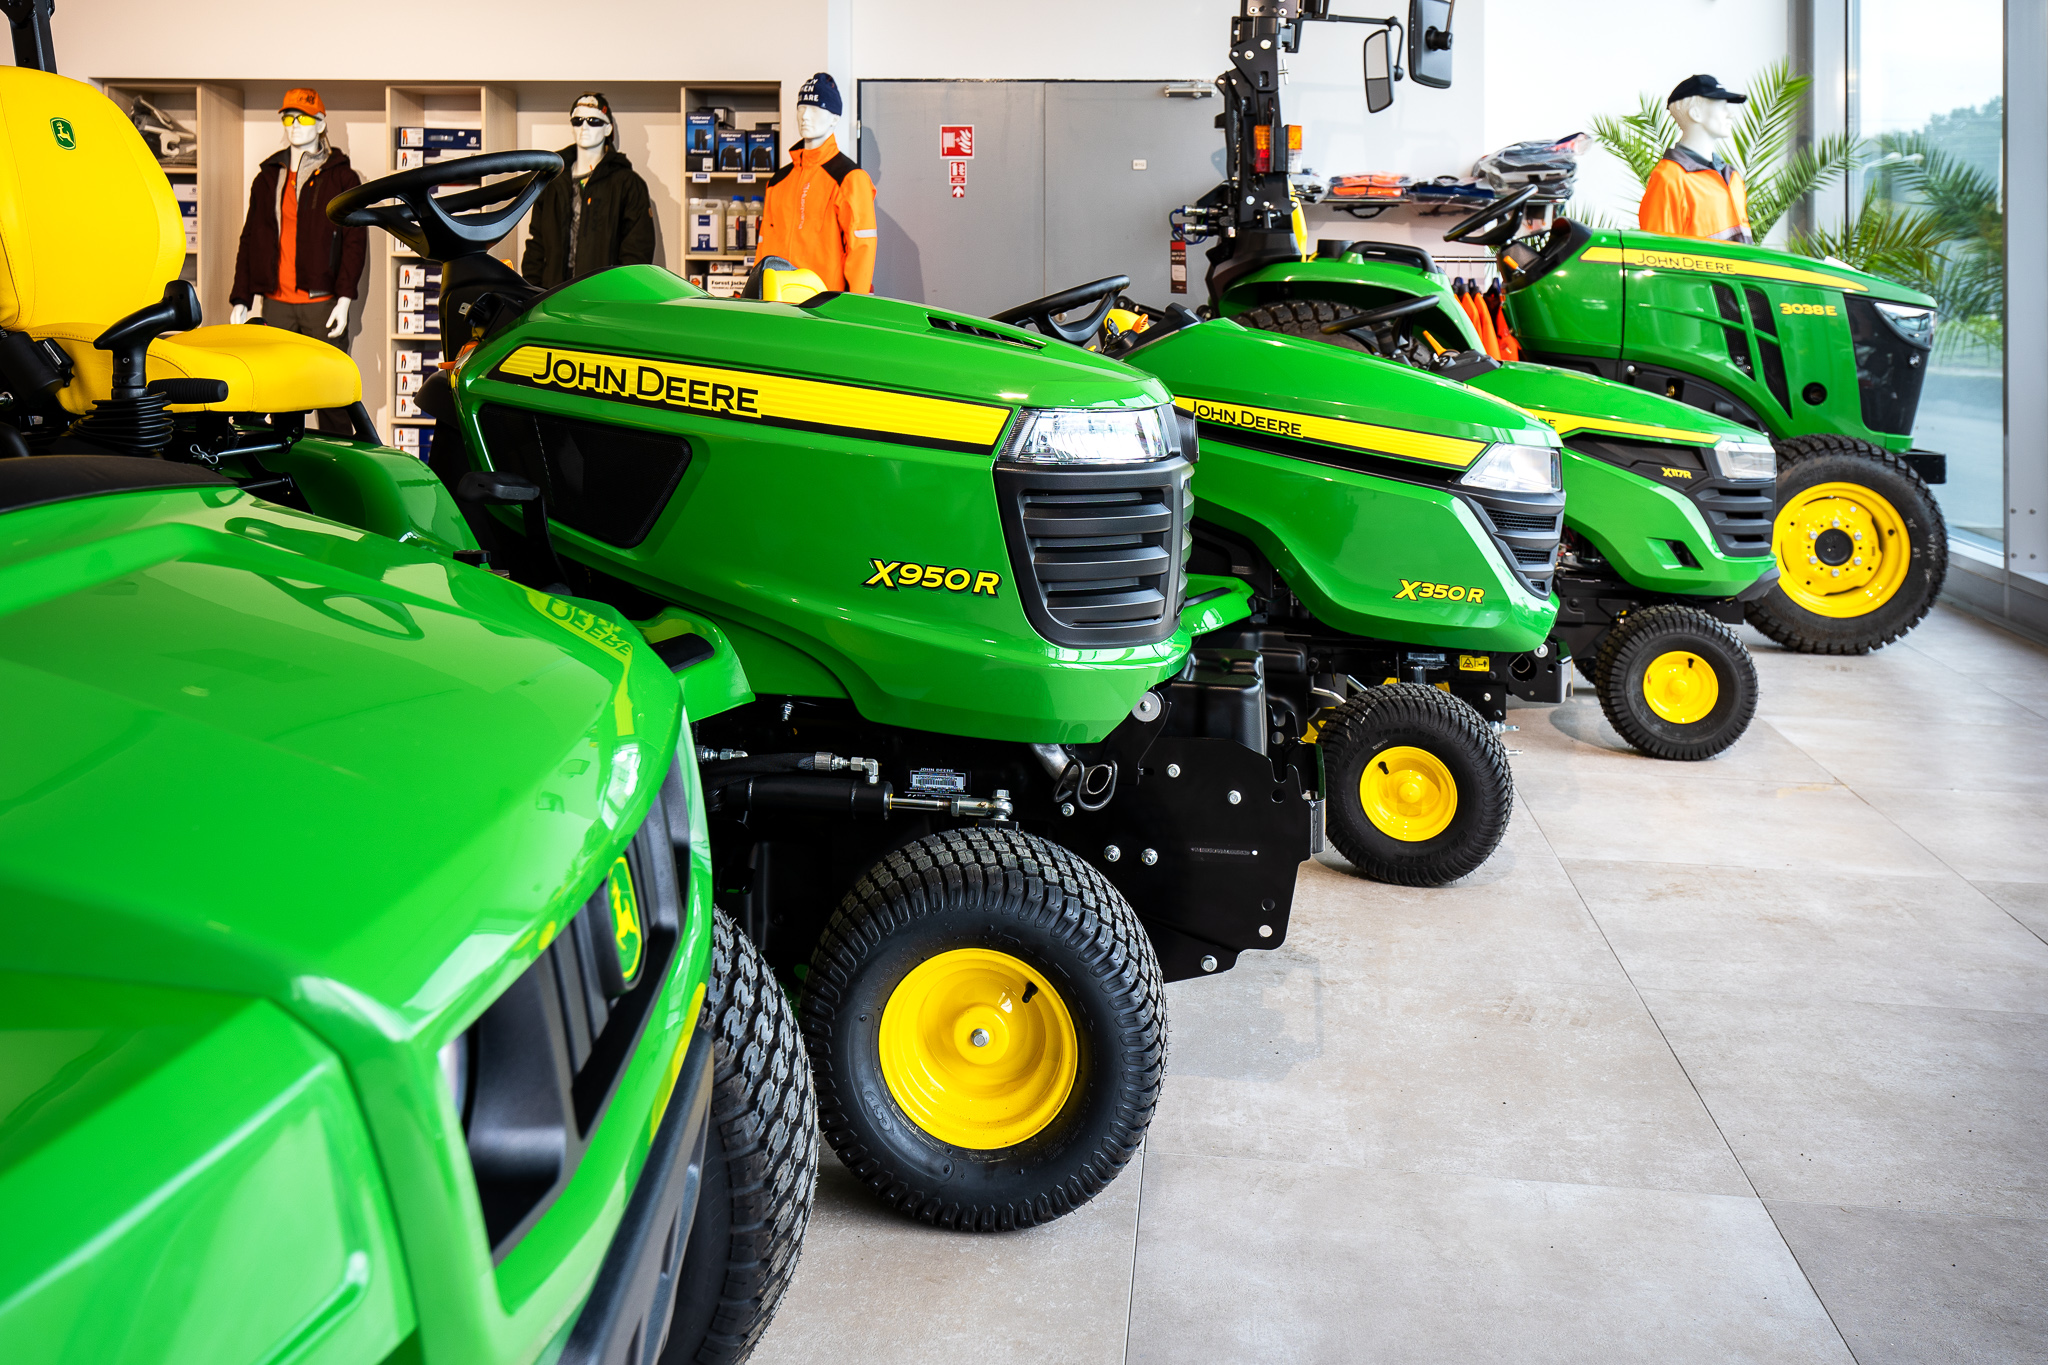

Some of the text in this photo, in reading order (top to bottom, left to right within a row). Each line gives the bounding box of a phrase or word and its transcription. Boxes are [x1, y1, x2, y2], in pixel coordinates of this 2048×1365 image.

[803, 94, 819, 102] ARE
[1637, 252, 1735, 273] JOHN DEERE
[532, 351, 759, 415] JOHN DEERE
[1192, 400, 1302, 436] JOHN DEERE
[1661, 466, 1692, 480] X117R
